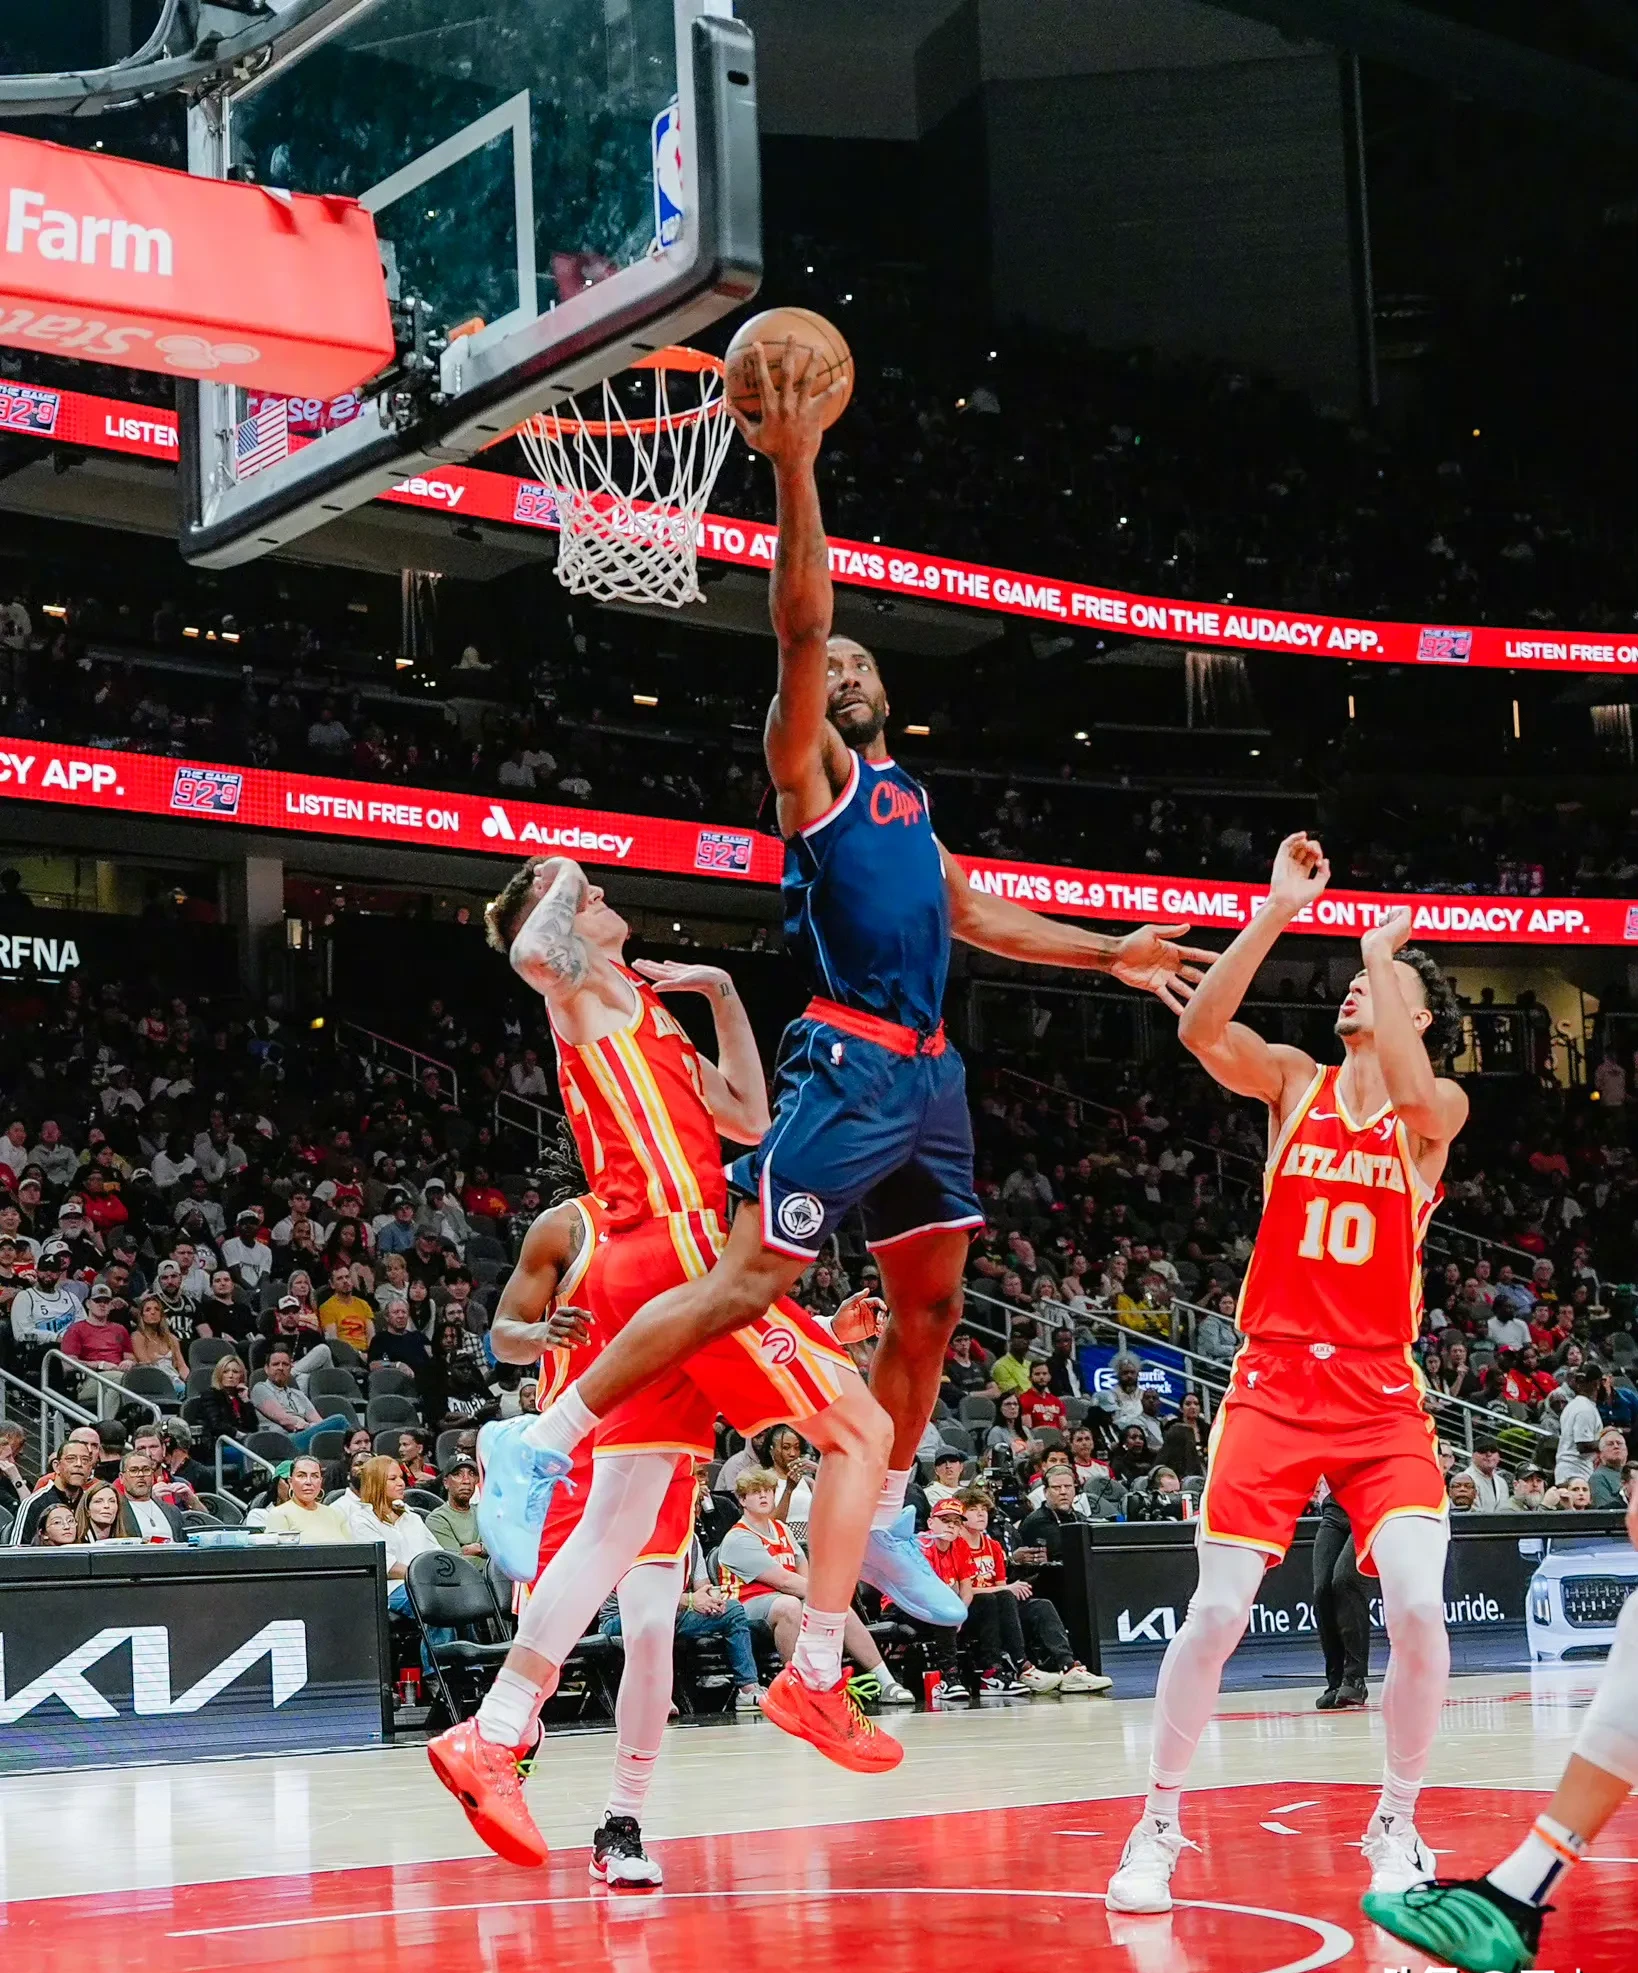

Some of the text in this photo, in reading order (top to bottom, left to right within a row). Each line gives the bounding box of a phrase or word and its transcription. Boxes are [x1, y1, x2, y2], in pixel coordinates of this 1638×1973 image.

[6, 187, 173, 276] Farm
[0, 307, 153, 355] Stat
[708, 526, 745, 554] TO
[750, 533, 885, 581] ATTA'S
[888, 559, 940, 590] 92.9
[941, 568, 990, 600] THE
[993, 578, 1067, 617] GAME,
[1072, 592, 1128, 625] FREE
[1130, 604, 1168, 630] ON
[1168, 609, 1220, 636] THE
[1223, 615, 1324, 647] AUDACY
[1327, 627, 1384, 653] APP.
[1505, 640, 1567, 660] LISTEN
[1570, 644, 1616, 663] FREE
[41, 759, 125, 796] APP.
[180, 769, 239, 784] THE GAME
[286, 792, 634, 858] LISTEN FREE ON Audacy
[701, 832, 721, 842] THE
[1054, 879, 1105, 907] 92.9
[1105, 884, 1159, 912] THE
[1162, 889, 1246, 922] GAME,
[1250, 896, 1314, 924] FE
[1317, 899, 1356, 926] ON
[1413, 905, 1524, 932] AUDACY
[1527, 909, 1591, 934] APP.
[1281, 1143, 1406, 1195] ATLANTA
[1298, 1196, 1376, 1266] 10
[1117, 1606, 1177, 1642] KI
